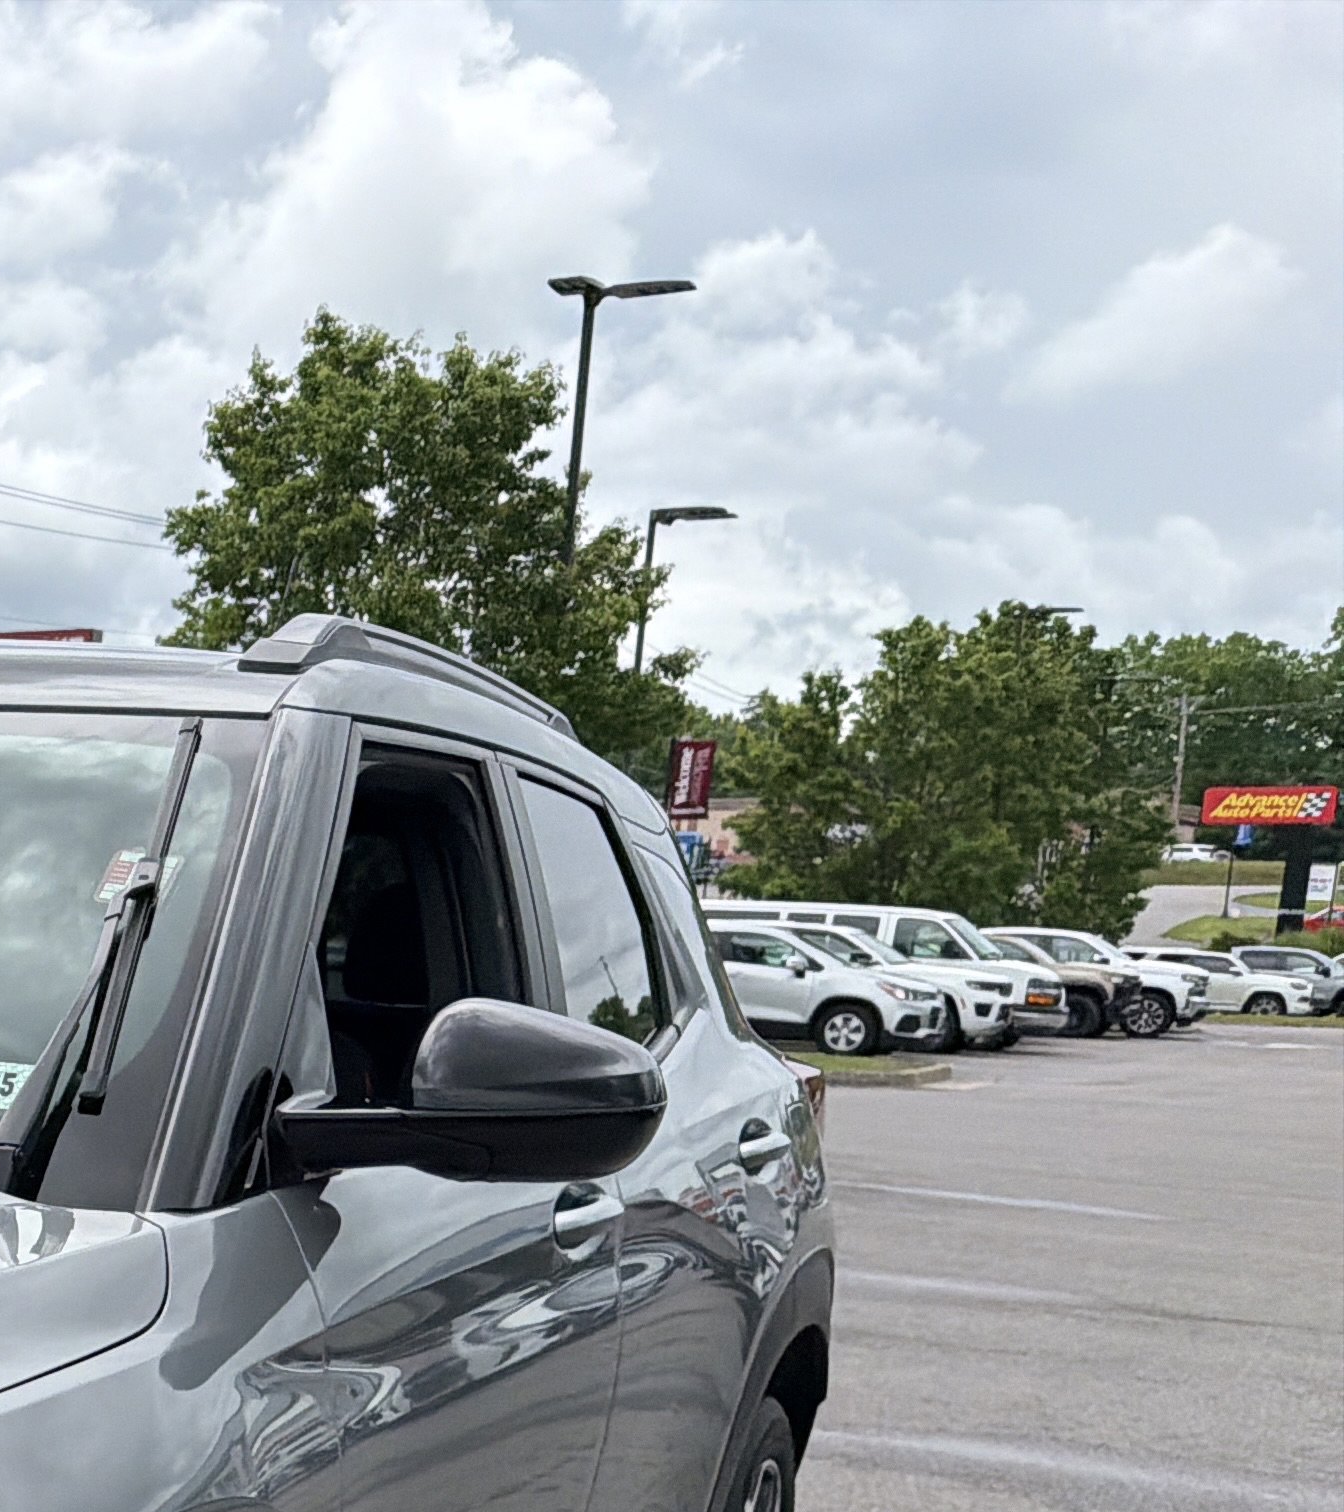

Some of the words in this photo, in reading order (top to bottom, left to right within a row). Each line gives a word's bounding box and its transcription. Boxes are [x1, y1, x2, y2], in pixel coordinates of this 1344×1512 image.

[1224, 792, 1300, 807] Advance
[1210, 803, 1250, 818] Auto
[0, 1071, 17, 1096] 5
